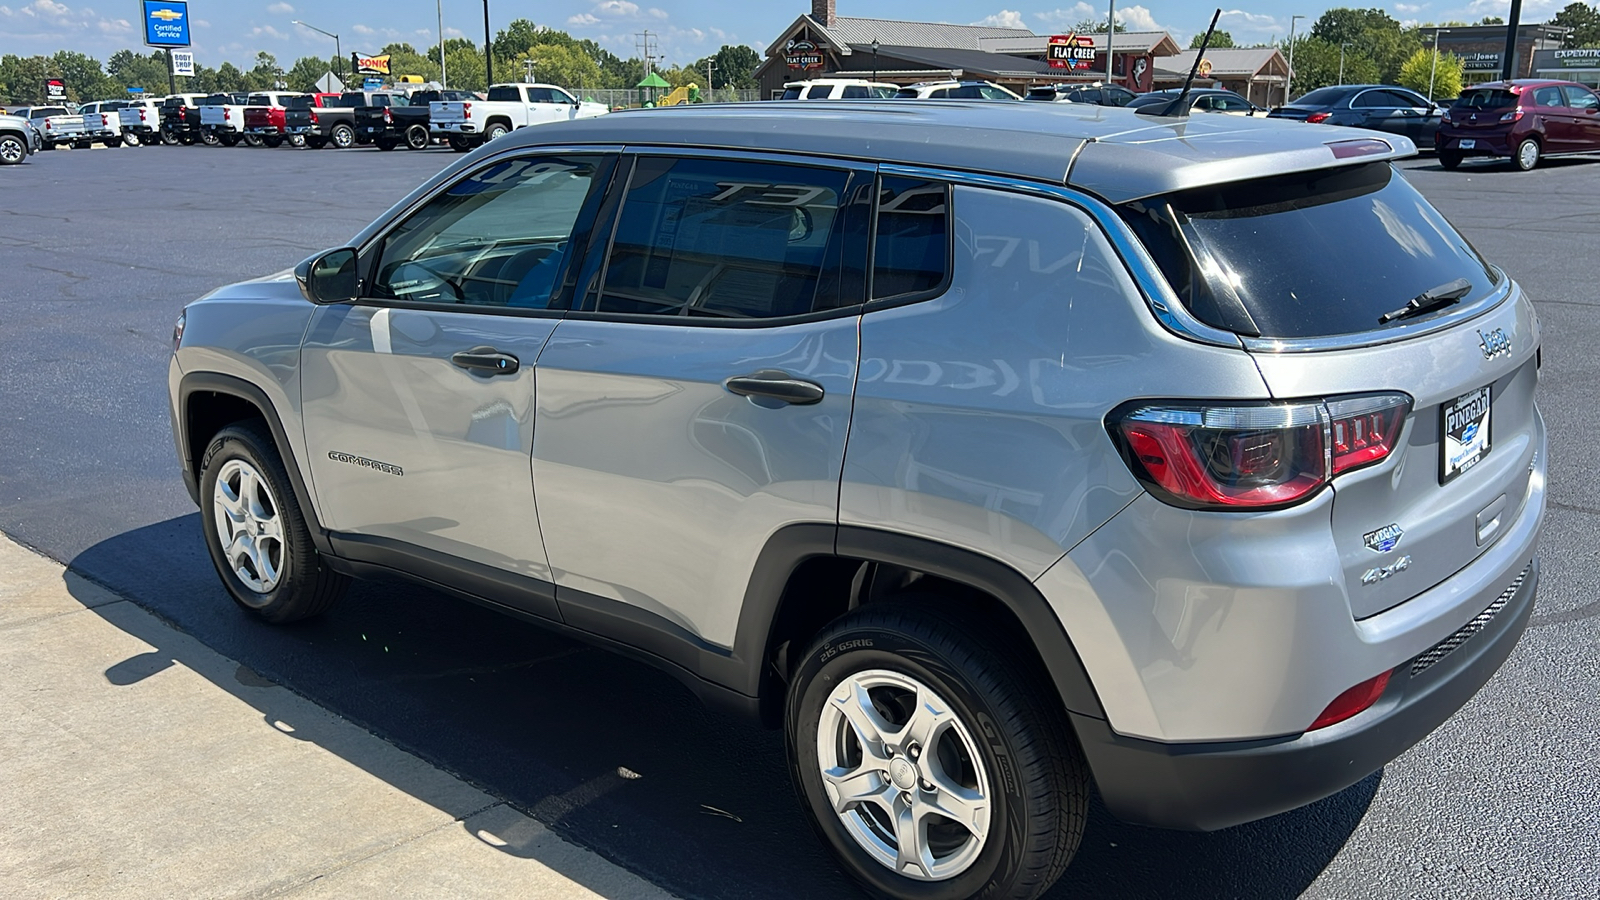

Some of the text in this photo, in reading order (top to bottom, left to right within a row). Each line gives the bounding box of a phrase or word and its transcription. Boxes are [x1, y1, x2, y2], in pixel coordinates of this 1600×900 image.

[154, 24, 182, 32] Certified
[1054, 47, 1096, 59] FLAT CREEK
[1476, 52, 1498, 61] Jones
[359, 59, 387, 69] SONIC
[1477, 327, 1512, 361] Jeep
[1447, 396, 1487, 433] PINEGAR
[327, 450, 404, 476] COMPASS
[1363, 524, 1402, 545] PINEGAR
[820, 639, 874, 662] 215/65R16
